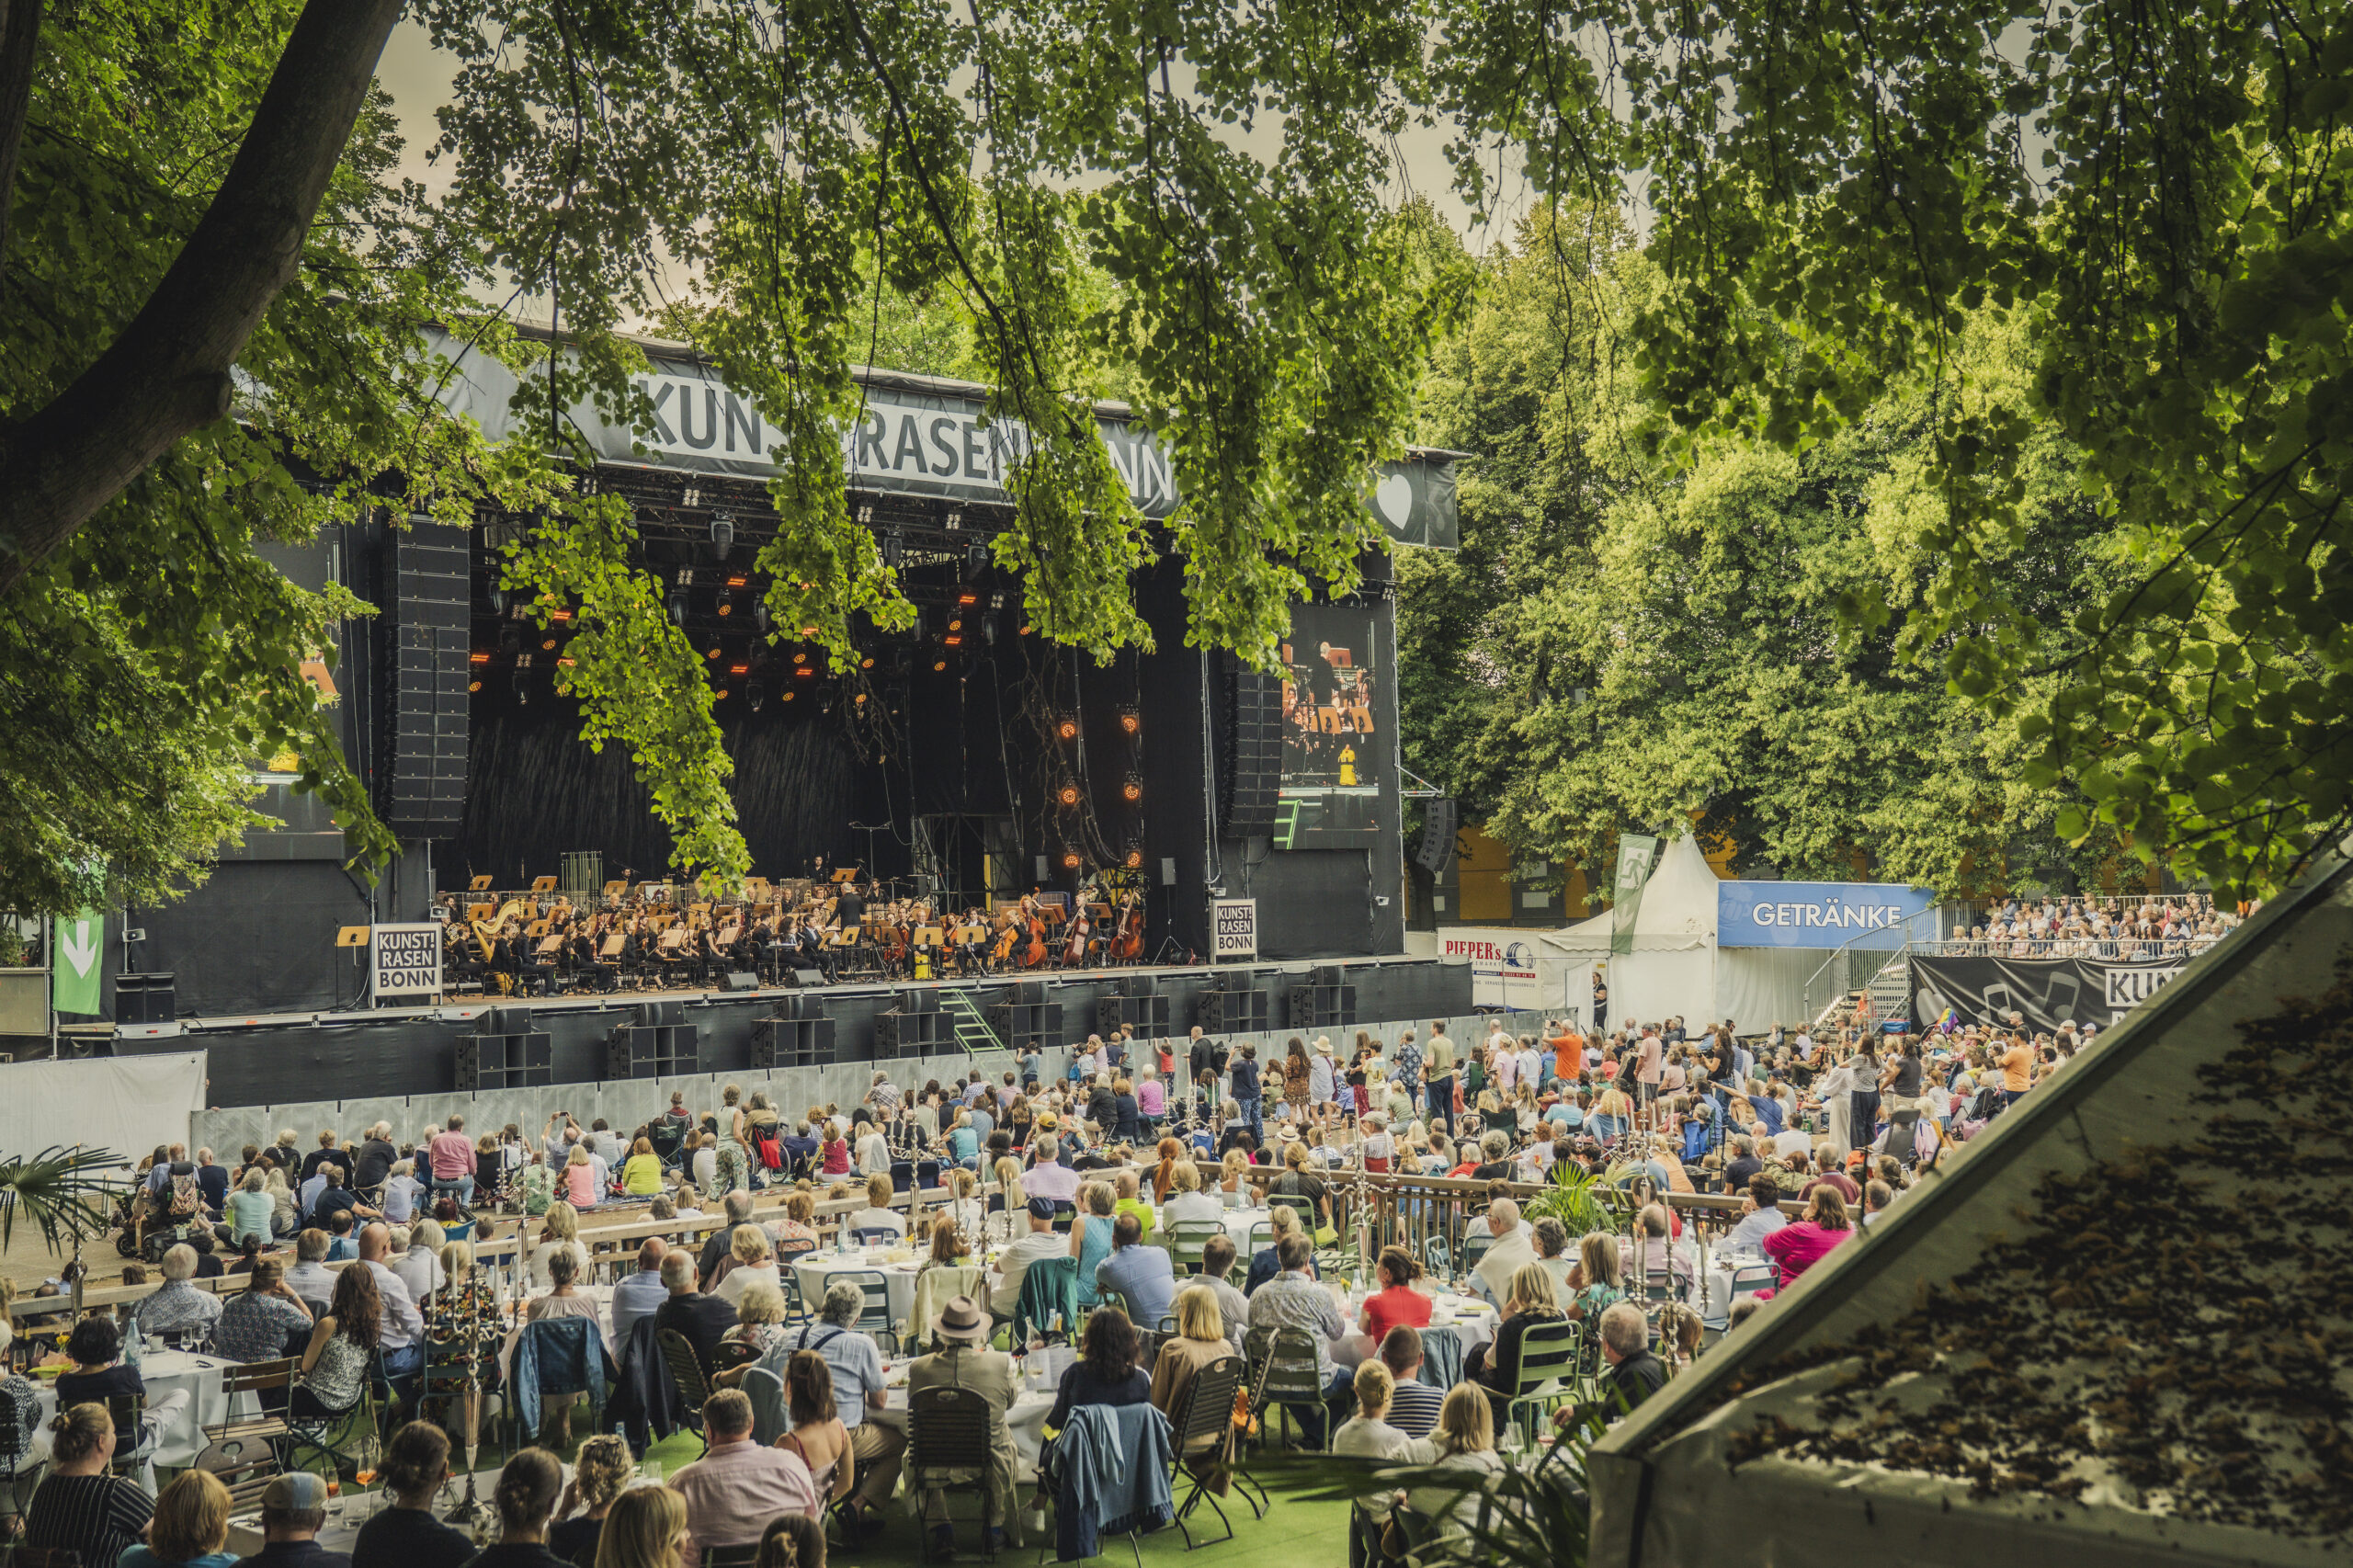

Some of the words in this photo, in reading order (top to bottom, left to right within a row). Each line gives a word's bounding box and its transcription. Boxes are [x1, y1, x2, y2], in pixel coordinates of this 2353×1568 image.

[1218, 906, 1252, 920] KUNST!
[1752, 896, 1902, 929] GETRÄNKE
[1220, 920, 1251, 934] RASEN
[379, 932, 436, 950] KUNST!
[1219, 936, 1253, 949] BONN
[382, 950, 433, 968] RASEN
[380, 970, 436, 988] BONN
